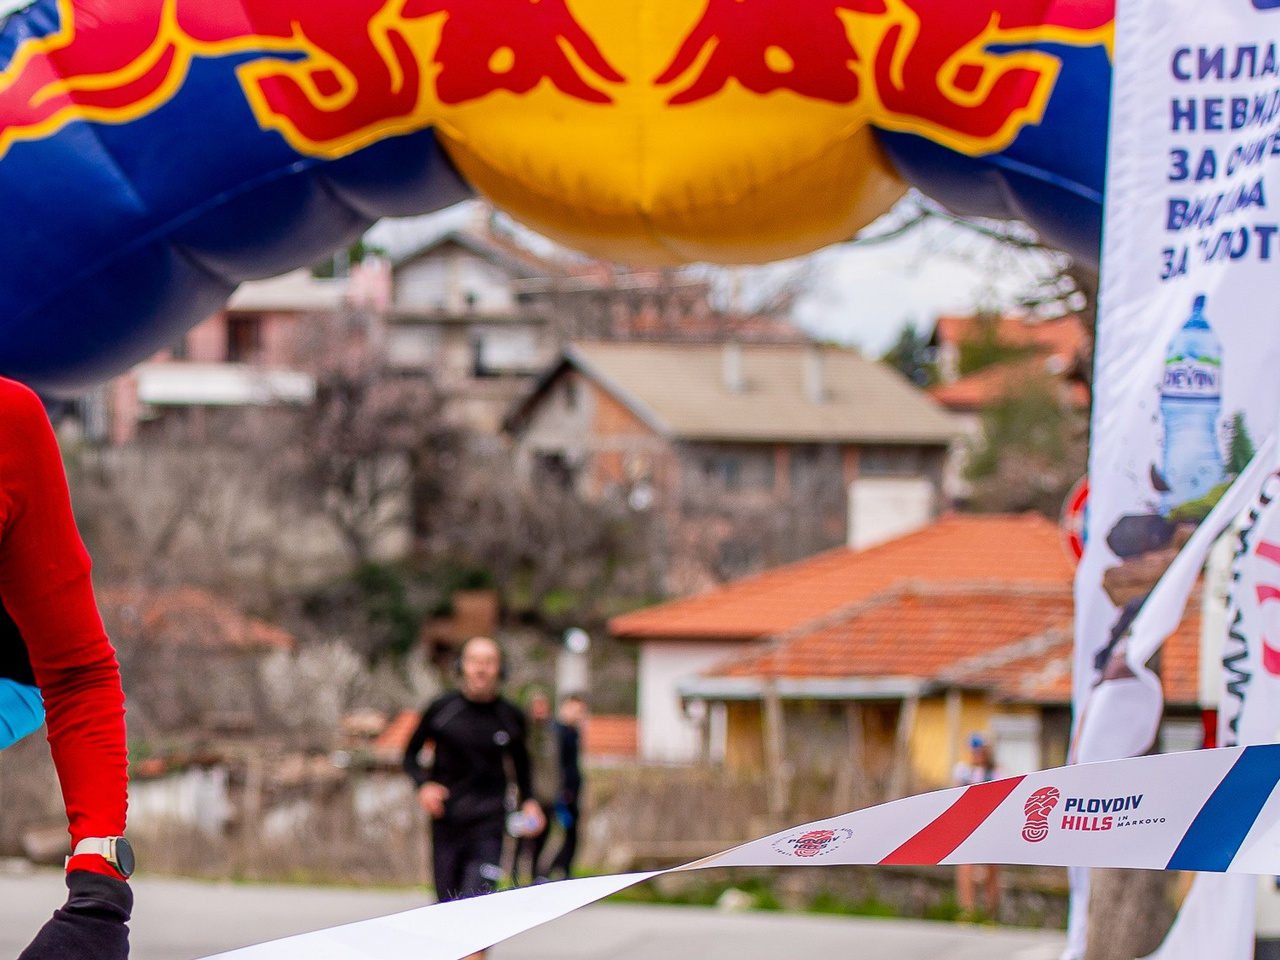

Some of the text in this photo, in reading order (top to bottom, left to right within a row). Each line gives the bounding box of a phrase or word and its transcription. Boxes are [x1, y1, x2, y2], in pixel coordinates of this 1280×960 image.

[1168, 148, 1217, 181] ЗА
[1064, 793, 1144, 813] PLOVDIV
[1061, 815, 1114, 831] HILLS
[1117, 817, 1166, 828] MARKOVO
